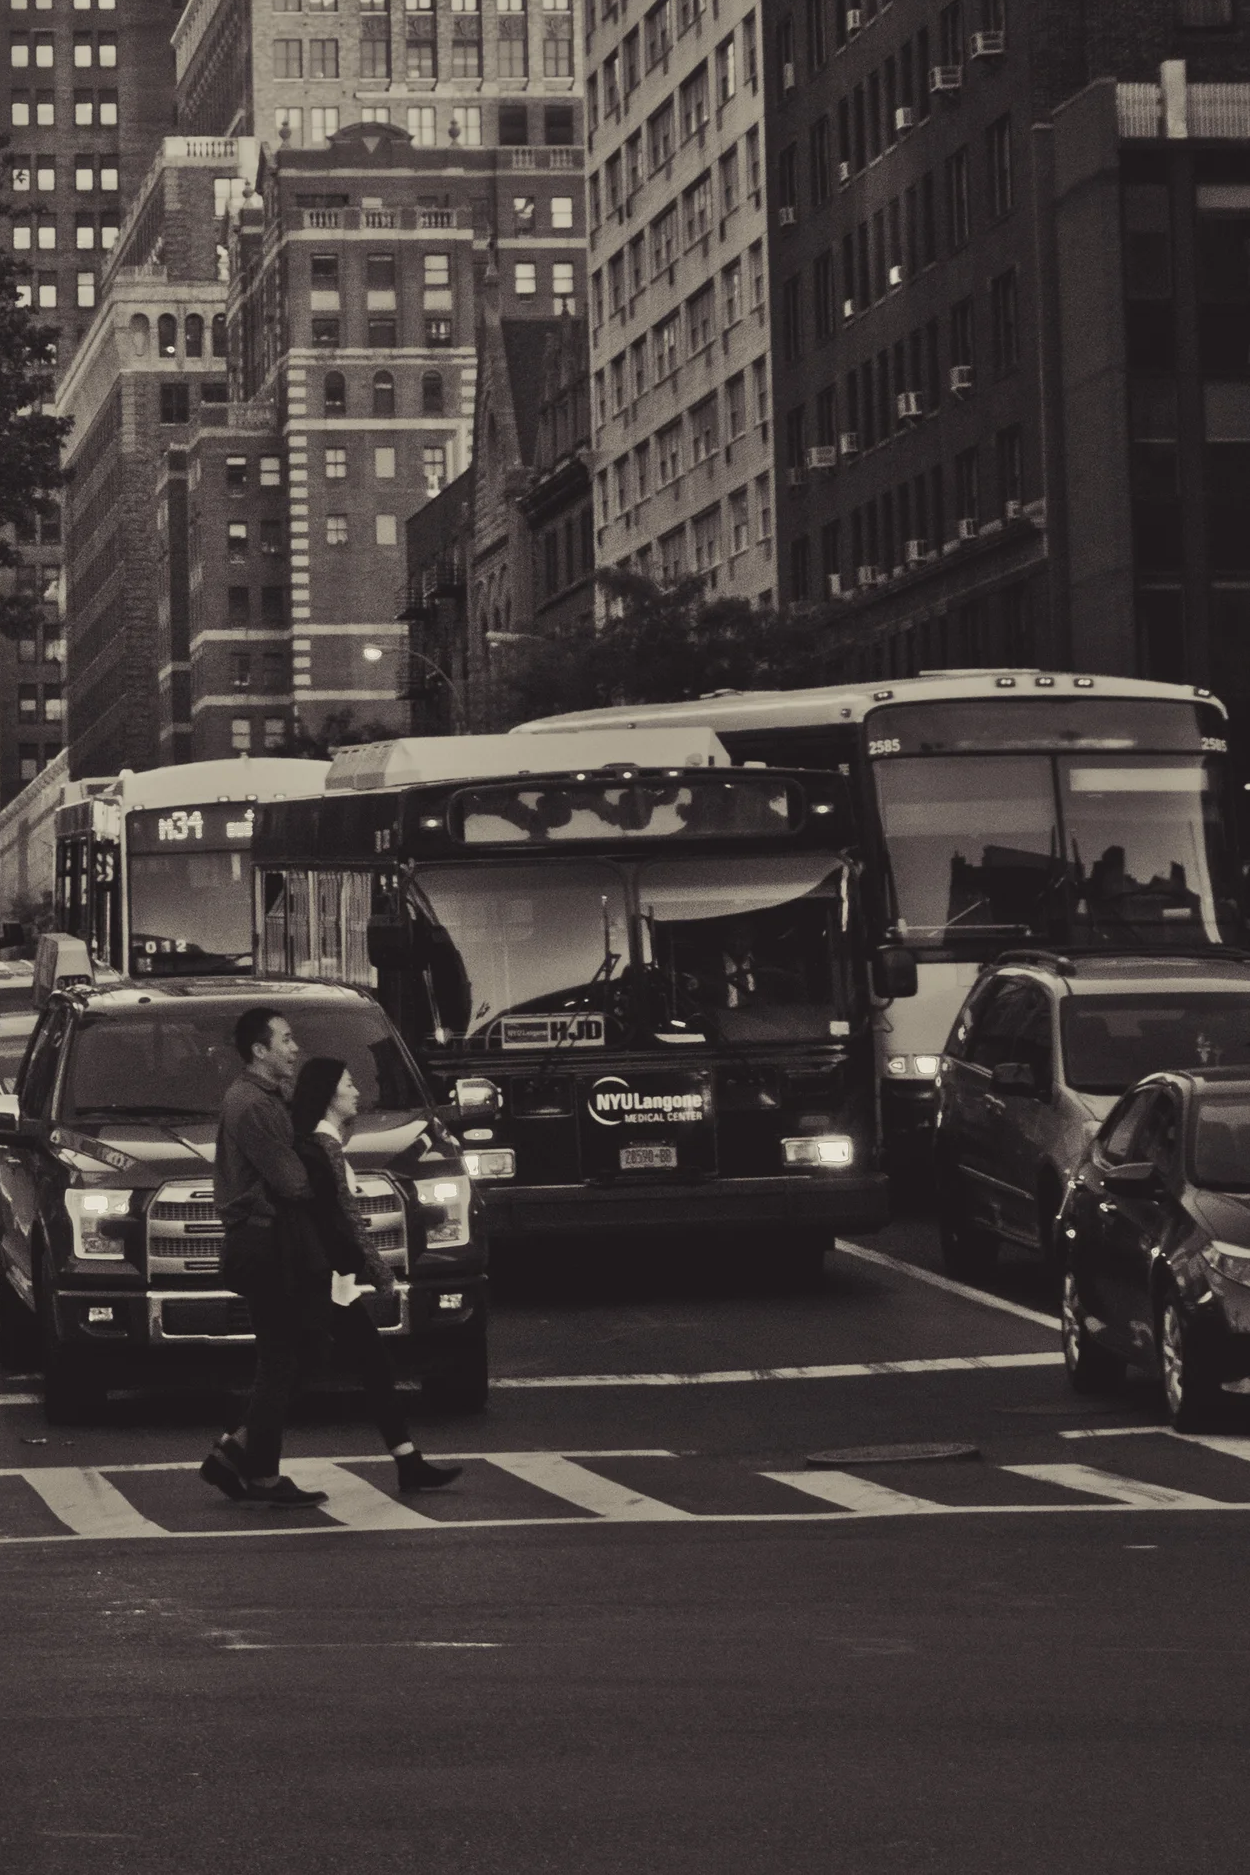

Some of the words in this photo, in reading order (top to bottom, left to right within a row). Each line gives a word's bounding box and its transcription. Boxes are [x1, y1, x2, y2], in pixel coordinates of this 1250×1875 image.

[868, 738, 901, 755] 2585
[158, 810, 204, 841] M34
[550, 1020, 602, 1041] HJD
[624, 1113, 665, 1123] MEDICAL
[666, 1111, 703, 1122] CENTER
